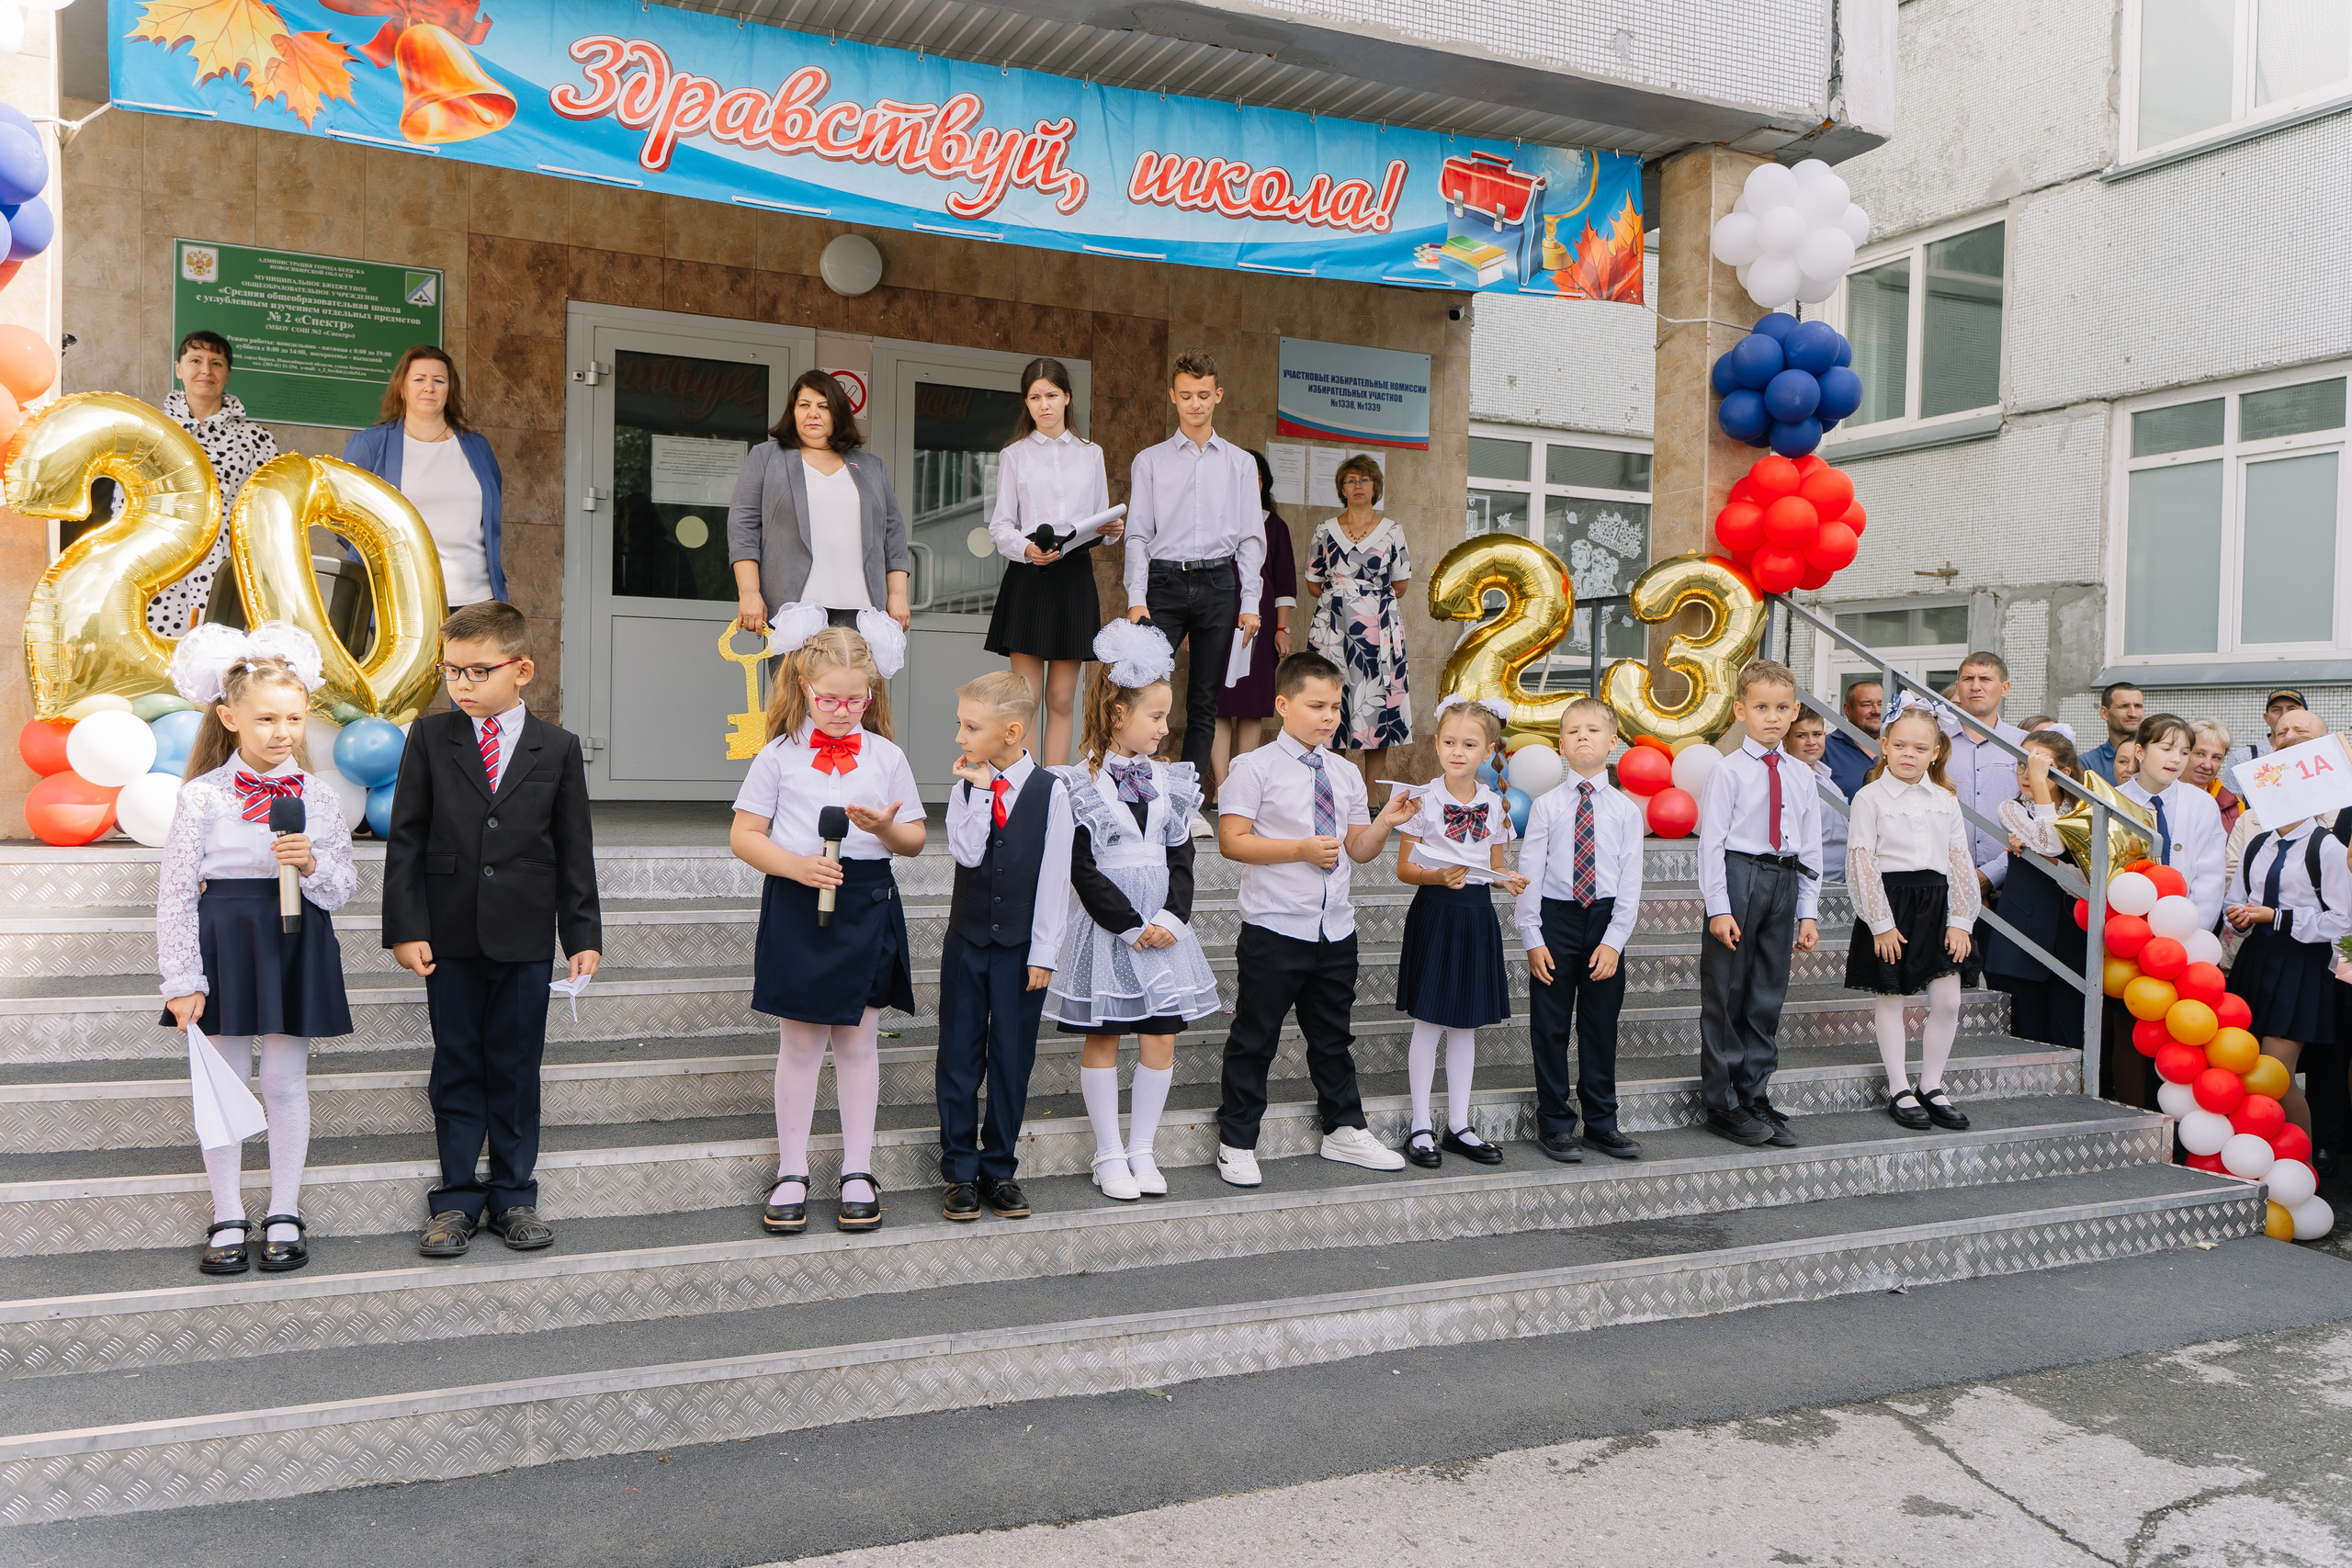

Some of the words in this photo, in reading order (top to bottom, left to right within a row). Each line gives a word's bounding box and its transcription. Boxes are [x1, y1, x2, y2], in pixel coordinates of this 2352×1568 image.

[548, 35, 1090, 220] Здравствуй,
[1127, 150, 1409, 234] школа!
[258, 257, 312, 268] АДМИНИСТРАЦИЯ
[314, 263, 337, 272] ГОРОДА
[338, 266, 365, 275] БЕРДСКА
[269, 265, 324, 276] НОВОСИБИРСКОЙ
[325, 271, 354, 279] ОБЛАСТИ
[242, 280, 330, 296] ОБЩЕОБРАЗОВАТЕЛЬНОЕ
[332, 290, 379, 302] УЧРЕЖДЕНИЕ
[254, 274, 321, 288] МУНИЦИПАЛЬНОЕ
[322, 282, 368, 293] БЮДЖЕТНОЕ
[203, 295, 268, 308] углубленным
[270, 302, 320, 314] изучением
[322, 309, 372, 320] отдельных
[374, 313, 422, 325] предметов
[218, 286, 265, 299] «Средняя
[266, 292, 368, 310] общеобразовательная
[371, 304, 401, 314] школа
[266, 310, 282, 322] №
[284, 312, 291, 323] 2
[294, 315, 355, 332] «Спектр»
[266, 323, 289, 332] (МБОУ
[291, 327, 310, 335] СОШ
[311, 328, 322, 336] №2
[322, 331, 356, 339] «Спектр»)
[227, 334, 249, 343] Режим
[249, 337, 276, 345] работы:
[277, 341, 317, 349] понедельник
[310, 352, 347, 360] воскресенье
[353, 355, 383, 364] выходной
[1283, 369, 1329, 383] УЧАСТКОВЫЕ
[1330, 375, 1389, 389] ИЗБИРАТЕЛЬНЫЕ
[1389, 381, 1427, 394] КОМИССИИ
[1308, 384, 1367, 399] ИЗБИРАТЕЛЬНЫХ
[1368, 390, 1403, 402] УЧАСТКОВ
[1330, 398, 1356, 410] №1338,
[1357, 401, 1381, 412] №1339
[1588, 530, 1641, 559] сентября
[2295, 754, 2335, 781] 1А
